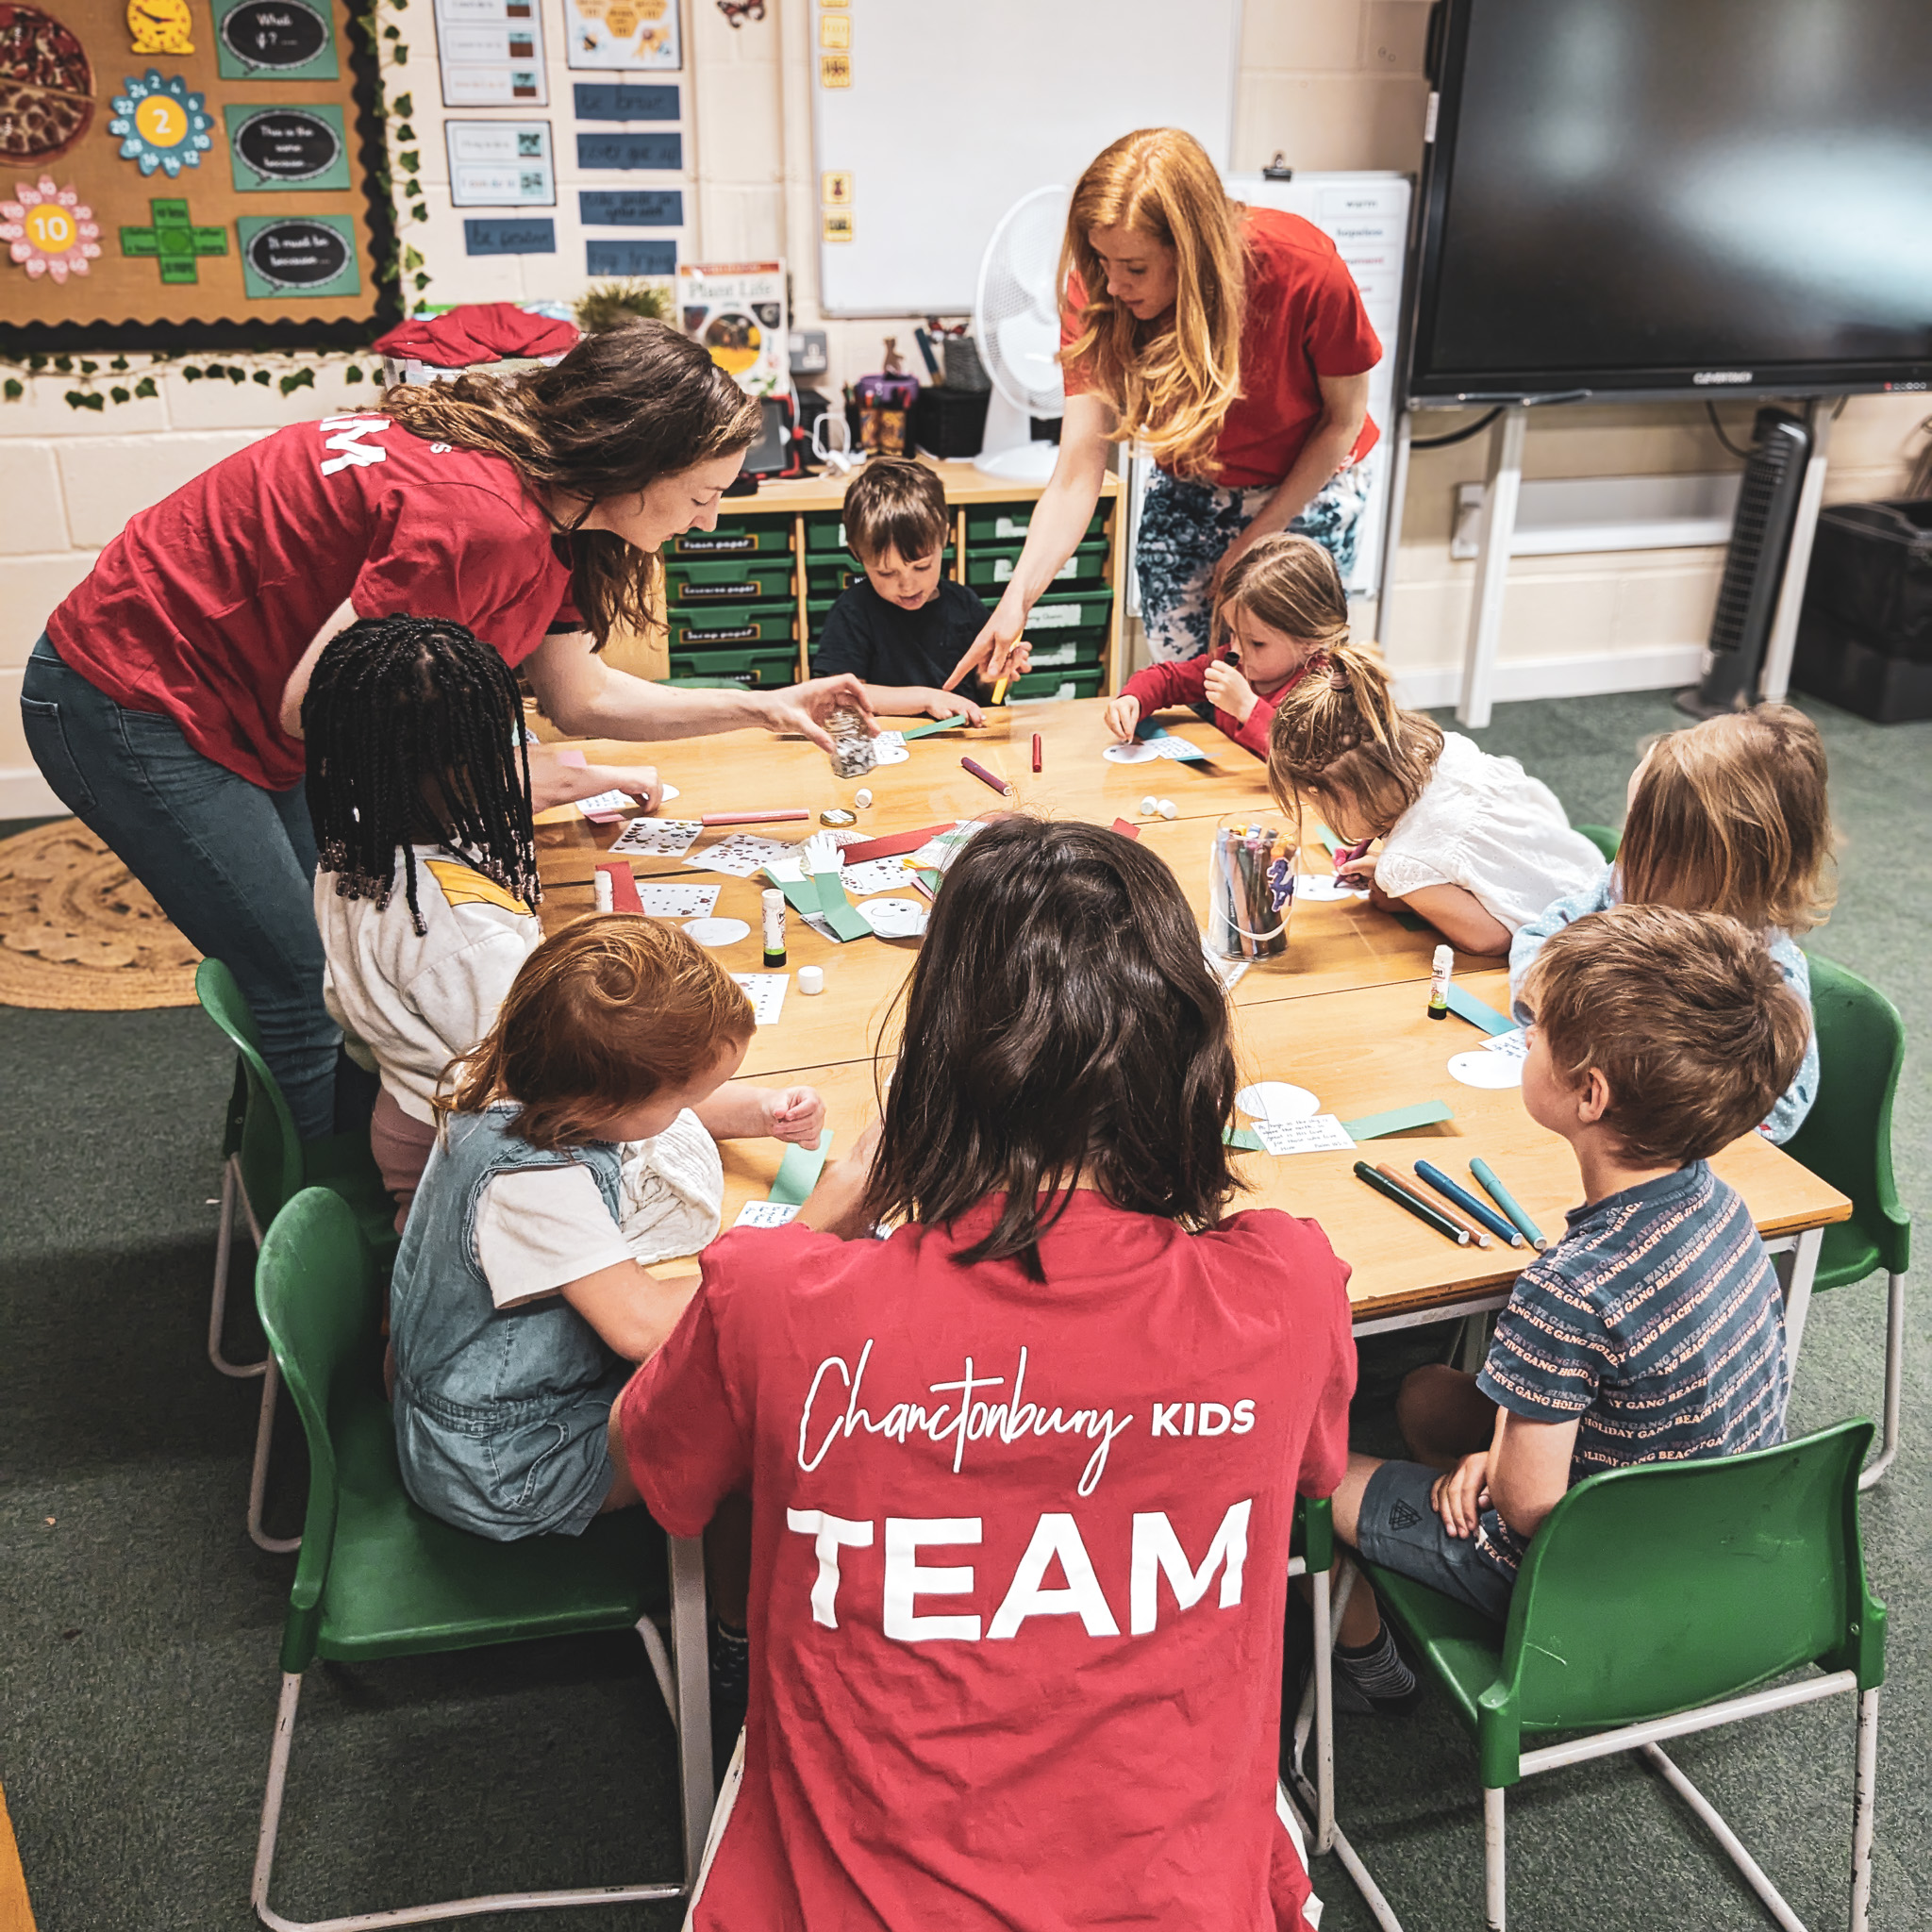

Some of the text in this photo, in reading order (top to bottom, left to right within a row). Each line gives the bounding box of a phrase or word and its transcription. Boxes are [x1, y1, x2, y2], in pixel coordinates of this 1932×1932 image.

[150, 75, 160, 89] 2
[110, 119, 130, 134] 20
[153, 108, 172, 134] 2
[125, 139, 142, 153] 18
[192, 134, 209, 149] 10
[39, 182, 57, 195] 10
[58, 192, 77, 206] 20
[74, 206, 92, 220] 30
[34, 216, 68, 242] 10
[79, 224, 99, 238] 40
[1612, 1201, 1643, 1232] BEAC
[1596, 1259, 1628, 1285] GANG
[1660, 1212, 1684, 1234] GANG
[1540, 1280, 1565, 1299] JIVE
[1563, 1293, 1595, 1314] GANG
[1624, 1285, 1656, 1312] GANG
[1528, 1313, 1554, 1335] JIVE
[1553, 1329, 1588, 1346] GANG
[1587, 1342, 1619, 1368] HOLID
[1629, 1329, 1658, 1357] GANG
[1503, 1339, 1523, 1357] JIVE
[1523, 1352, 1557, 1373] GANG
[1657, 1358, 1679, 1375] ANG
[1492, 1371, 1586, 1411] JIVE GANG HOLID
[1625, 1398, 1666, 1409] GANG
[1668, 1377, 1708, 1402] BEACH
[798, 1339, 1256, 1496] Chanctonbury KIDS
[1585, 1417, 1634, 1439] HOLIDAY
[1637, 1421, 1673, 1439] GANG
[787, 1498, 1253, 1641] TEAM
